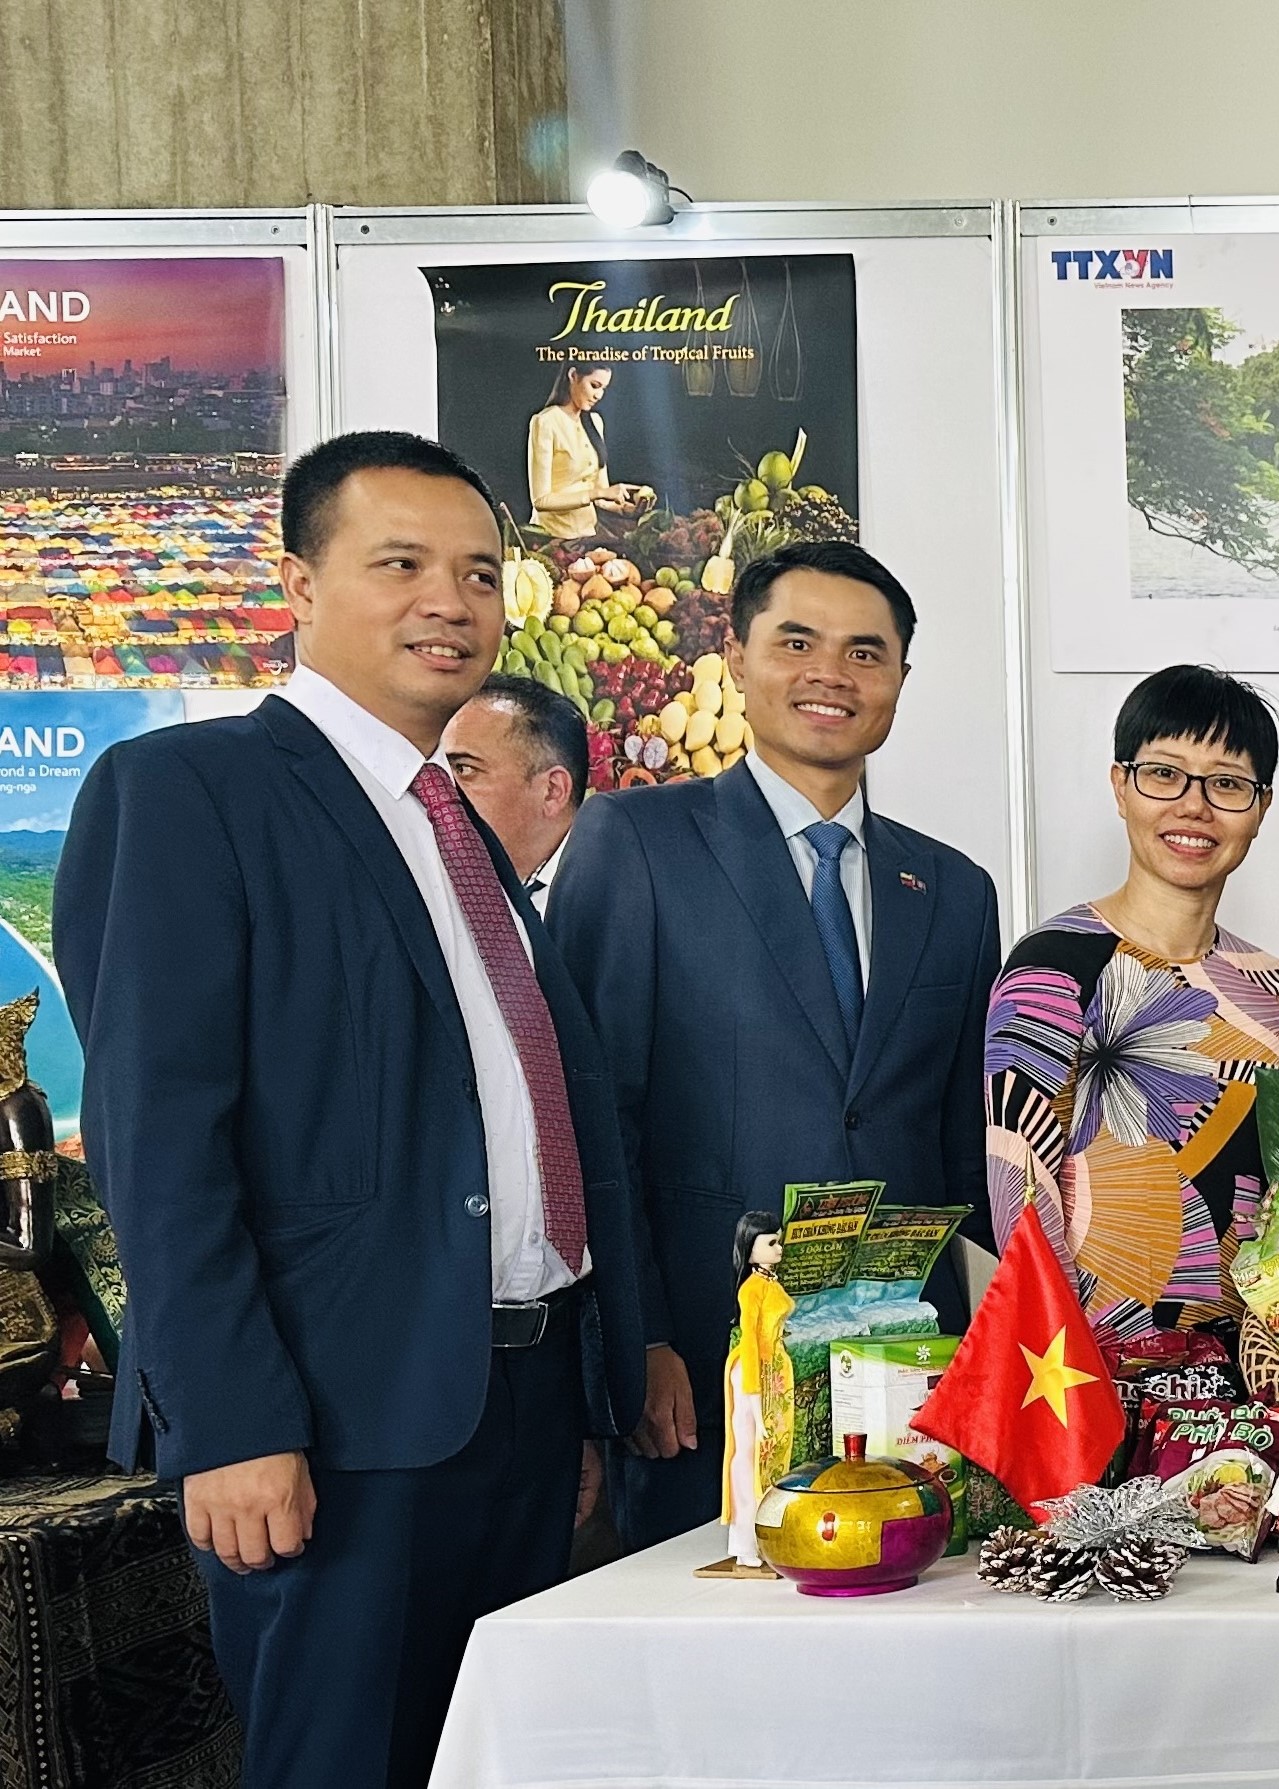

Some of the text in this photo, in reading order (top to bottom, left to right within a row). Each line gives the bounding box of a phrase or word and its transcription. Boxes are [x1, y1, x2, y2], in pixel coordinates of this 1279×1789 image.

[1052, 249, 1173, 280] TTXVN
[548, 280, 740, 341] Thailand
[4, 332, 77, 344] Satisfaction
[3, 346, 41, 357] Market
[536, 345, 754, 364] The Paradise of Tropical Fruits
[28, 769, 36, 777] a
[40, 765, 81, 777] Dream
[1231, 1421, 1274, 1452] BÒ
